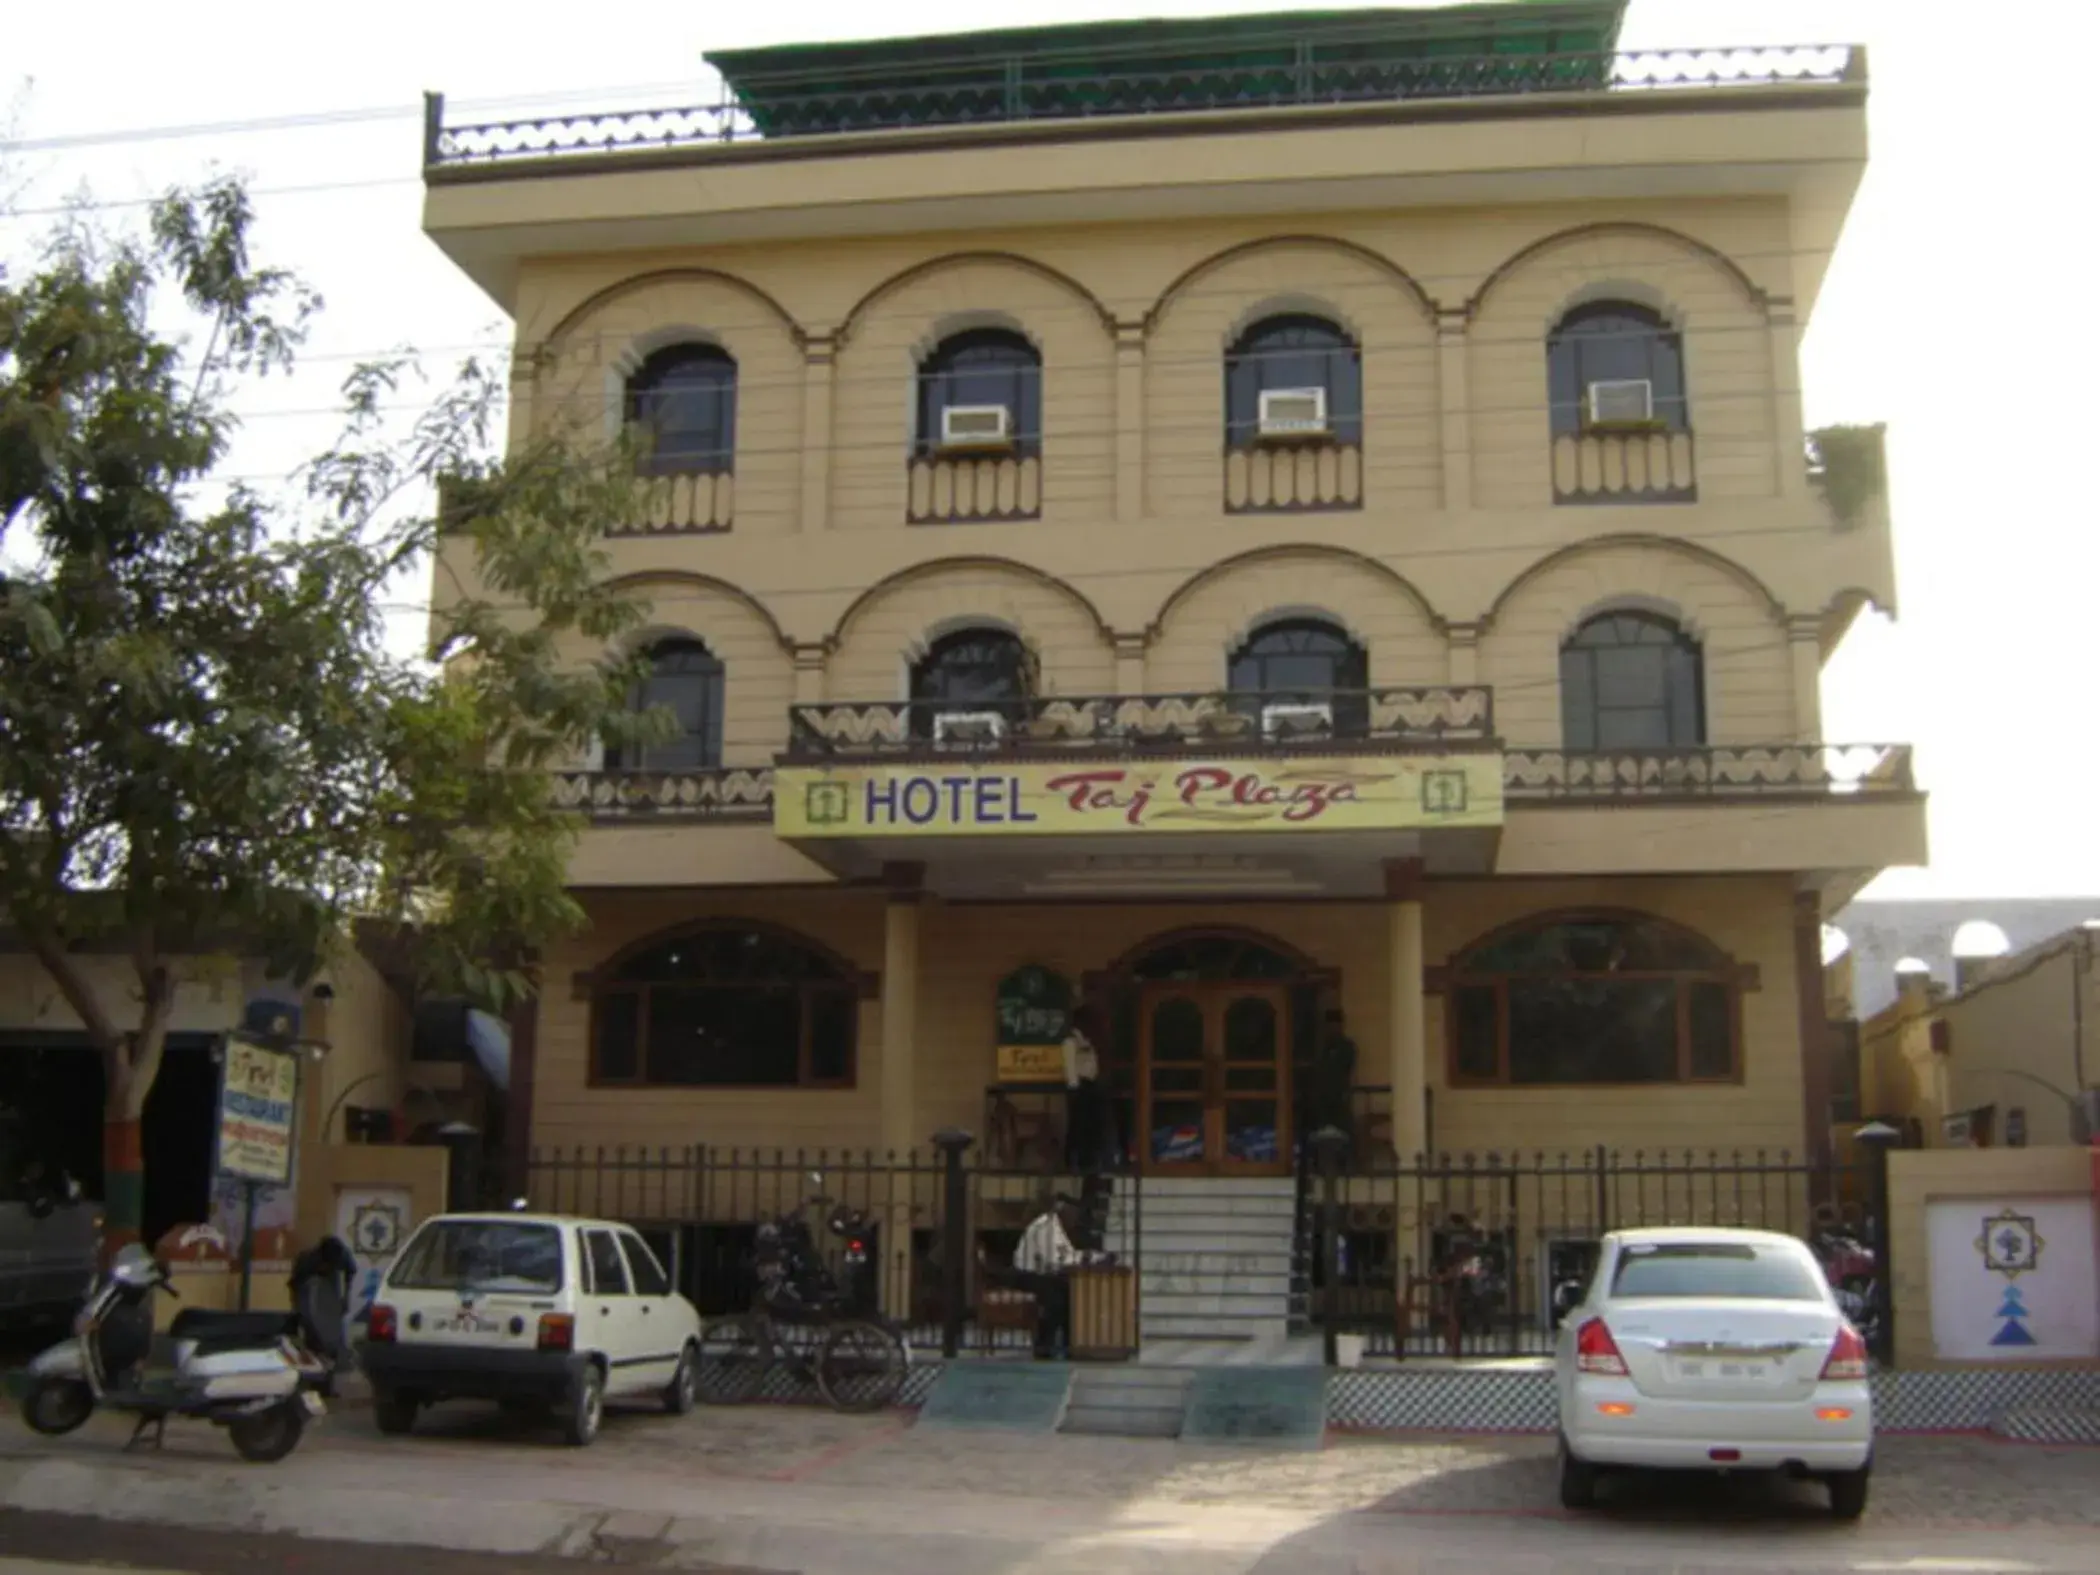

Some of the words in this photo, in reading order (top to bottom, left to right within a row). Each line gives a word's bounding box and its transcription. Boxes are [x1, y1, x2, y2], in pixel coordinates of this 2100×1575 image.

[865, 776, 1038, 825] HOTEL
[1045, 770, 1156, 827] Taj
[1174, 766, 1362, 822] Plaza
